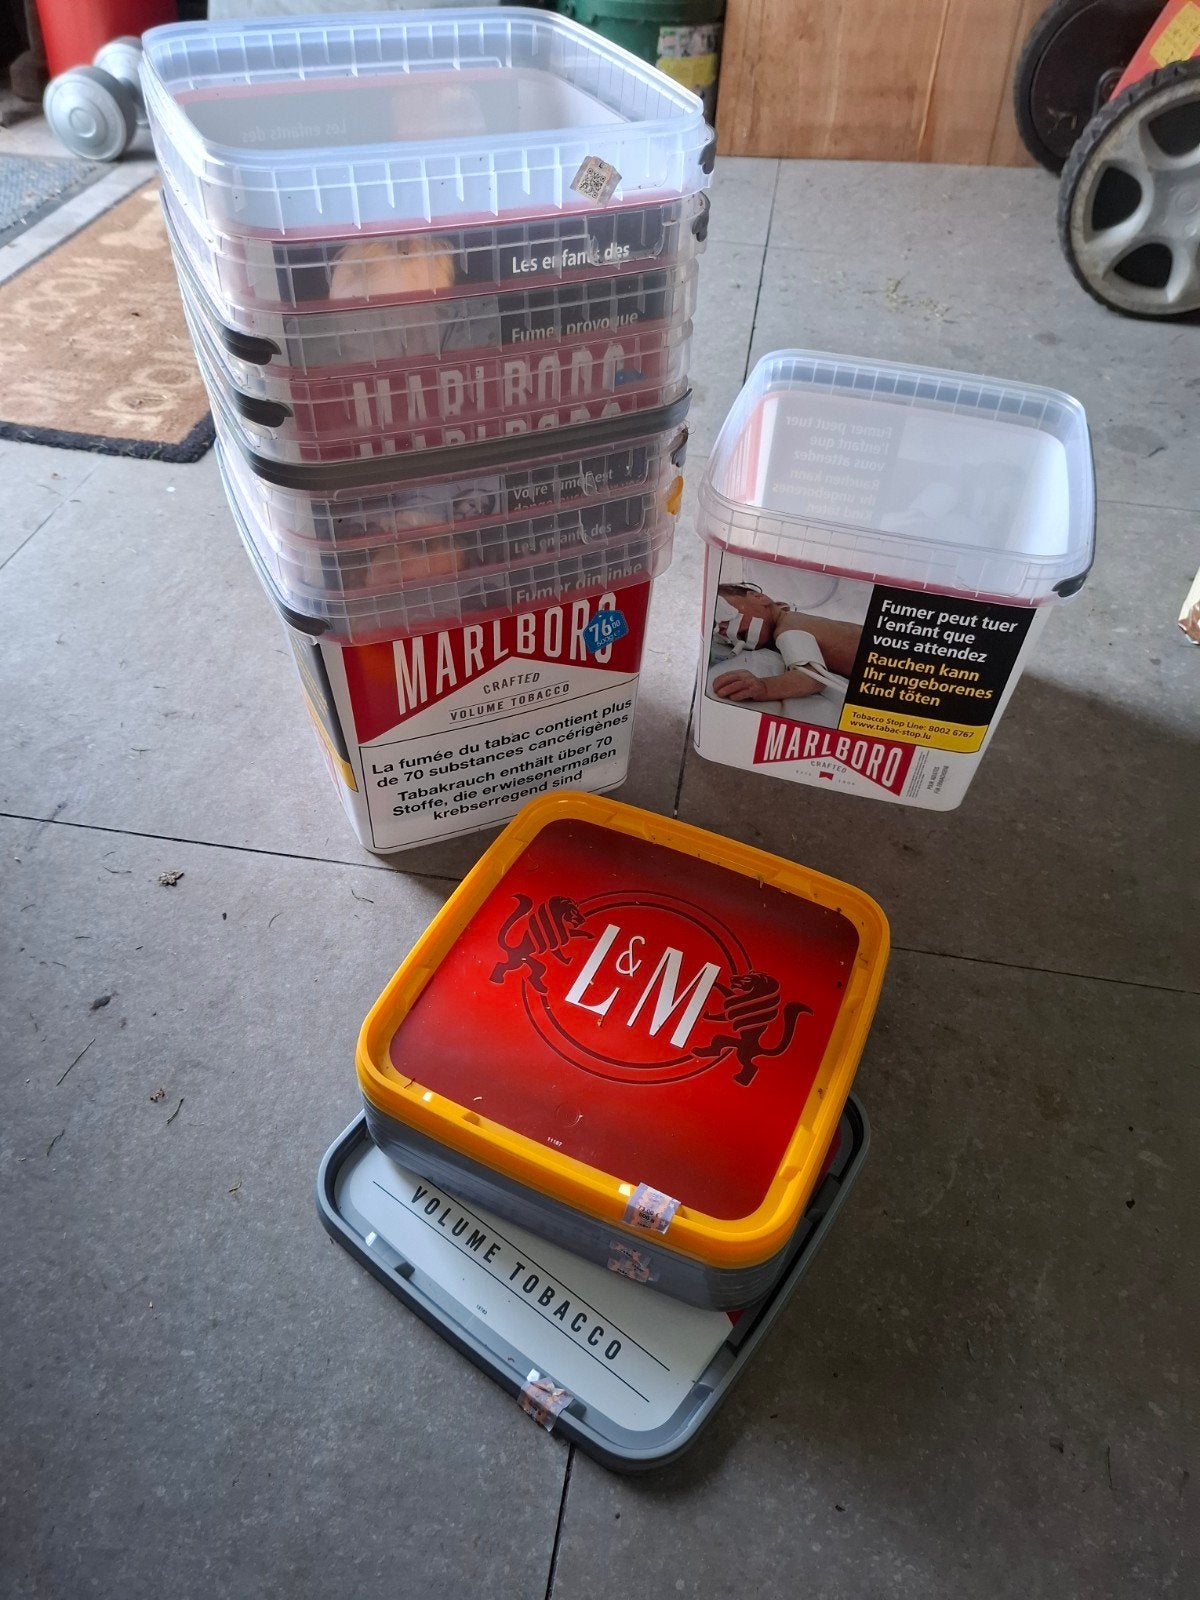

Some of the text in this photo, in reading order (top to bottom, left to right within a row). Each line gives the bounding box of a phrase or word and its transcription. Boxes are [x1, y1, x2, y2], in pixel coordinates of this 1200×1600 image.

[512, 256, 538, 274] Les
[604, 242, 630, 261] des
[512, 312, 639, 344] Fume provoue
[513, 485, 548, 500] Vore
[881, 599, 1018, 633] Fumer peut tuer
[873, 635, 988, 663] vous attendez
[943, 630, 976, 644] que
[867, 651, 980, 682] Rauchen kann
[483, 672, 540, 694] CRAFTED
[859, 682, 941, 707] Kind töten
[863, 667, 993, 699] Ihr ungeborenes
[450, 683, 570, 721] VOLUME TOBACCO
[372, 699, 632, 775] La fumée du tabac contient plus
[850, 719, 932, 740] www.tabac-stop.lu
[852, 711, 975, 738] Tobacco Stop Line: 8002 6767
[377, 713, 628, 788] de 70 substances cancérigènes
[763, 720, 903, 788] MARLBORO
[392, 748, 617, 817] Stoffe, die erwiesenermaßen
[398, 735, 613, 802] Tabakrauch enthält über 70
[810, 760, 848, 774] CRAFTED
[433, 769, 583, 820] krebserregend sind
[564, 923, 722, 1049] L&M
[411, 1185, 622, 1360] VOLUME TOBACCO
